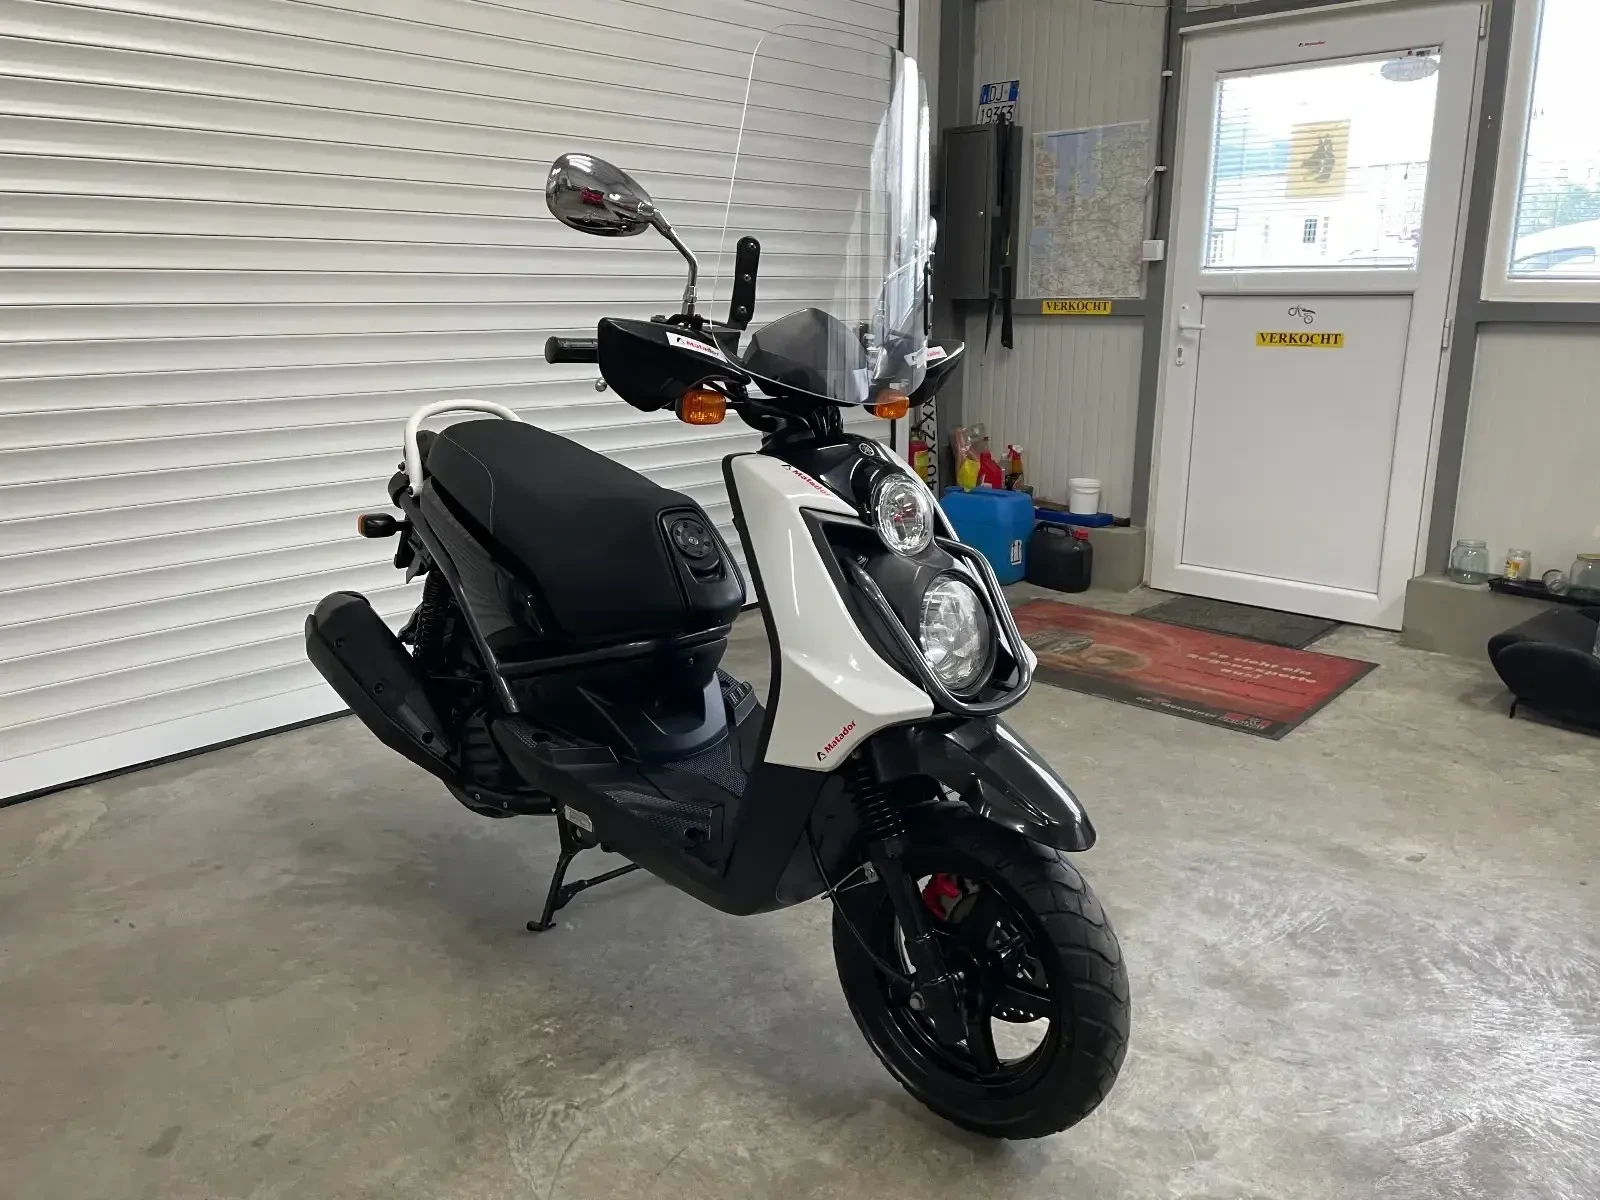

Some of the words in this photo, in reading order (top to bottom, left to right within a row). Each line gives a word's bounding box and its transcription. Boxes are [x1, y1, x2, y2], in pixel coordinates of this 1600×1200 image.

[1046, 301, 1110, 311] VERKOCHT
[1259, 332, 1342, 345] VERKOCHT
[686, 340, 719, 356] Matador
[792, 469, 831, 496] Matador
[823, 719, 857, 754] Matador
